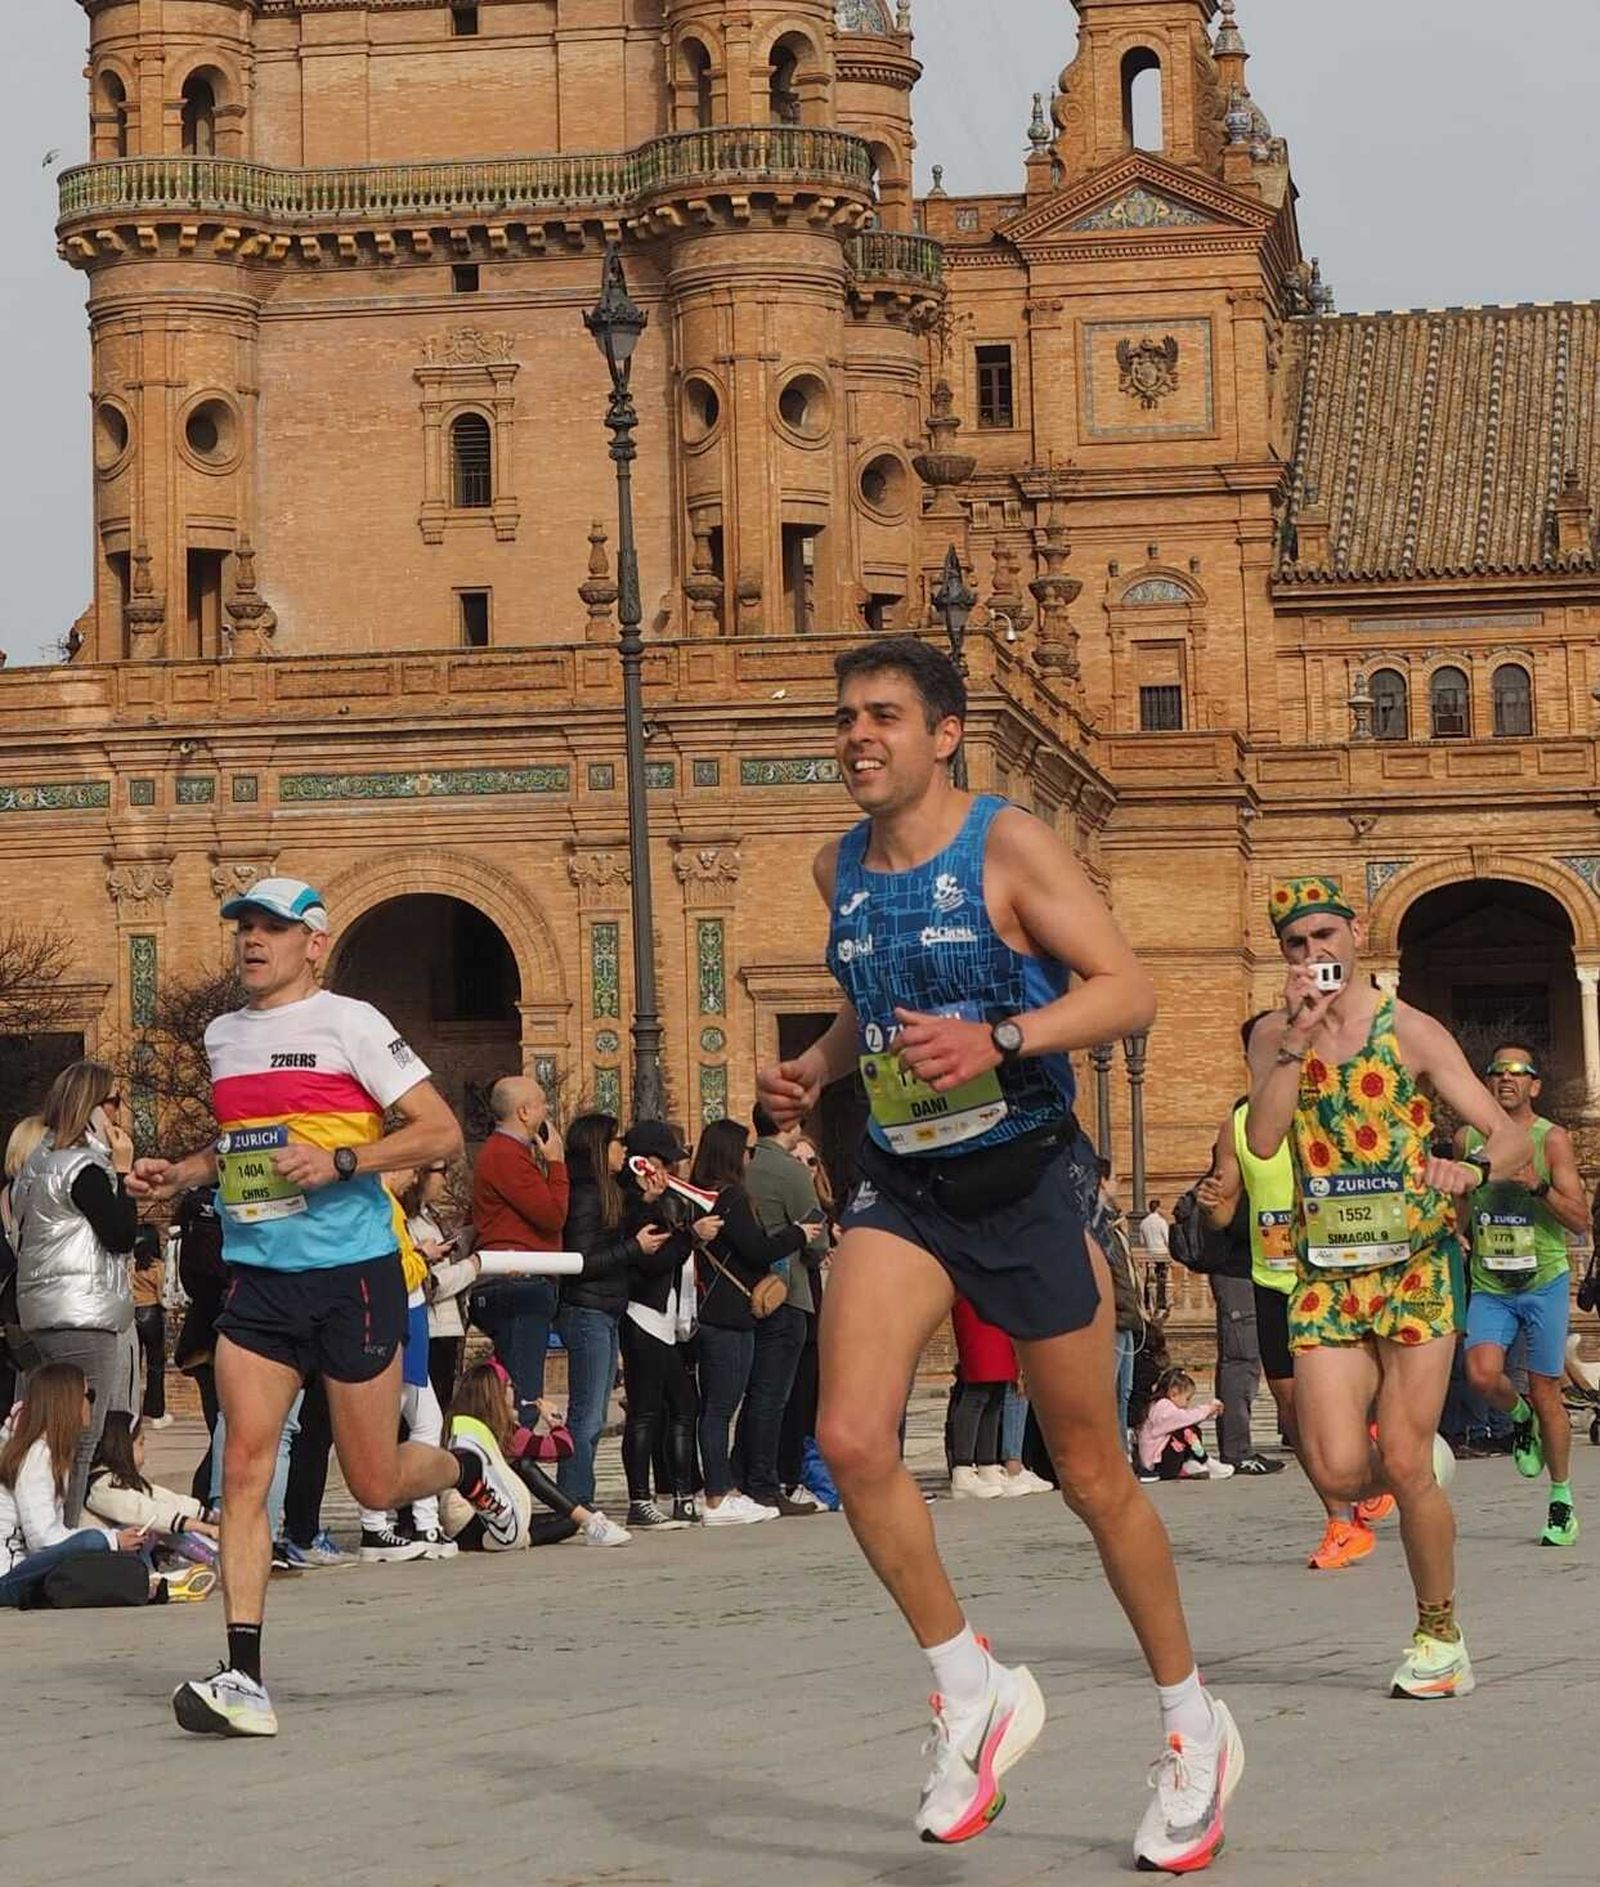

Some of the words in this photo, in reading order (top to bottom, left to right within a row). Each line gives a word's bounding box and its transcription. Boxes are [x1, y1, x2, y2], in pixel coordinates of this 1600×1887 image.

[270, 1053, 317, 1068] 226ERS
[911, 1097, 948, 1118] DANI
[234, 1131, 278, 1148] ZURICH
[238, 1163, 265, 1179] 1404
[1336, 1177, 1393, 1192] ZURICH
[241, 1187, 270, 1200] CHRIS
[1338, 1207, 1372, 1222] 1552
